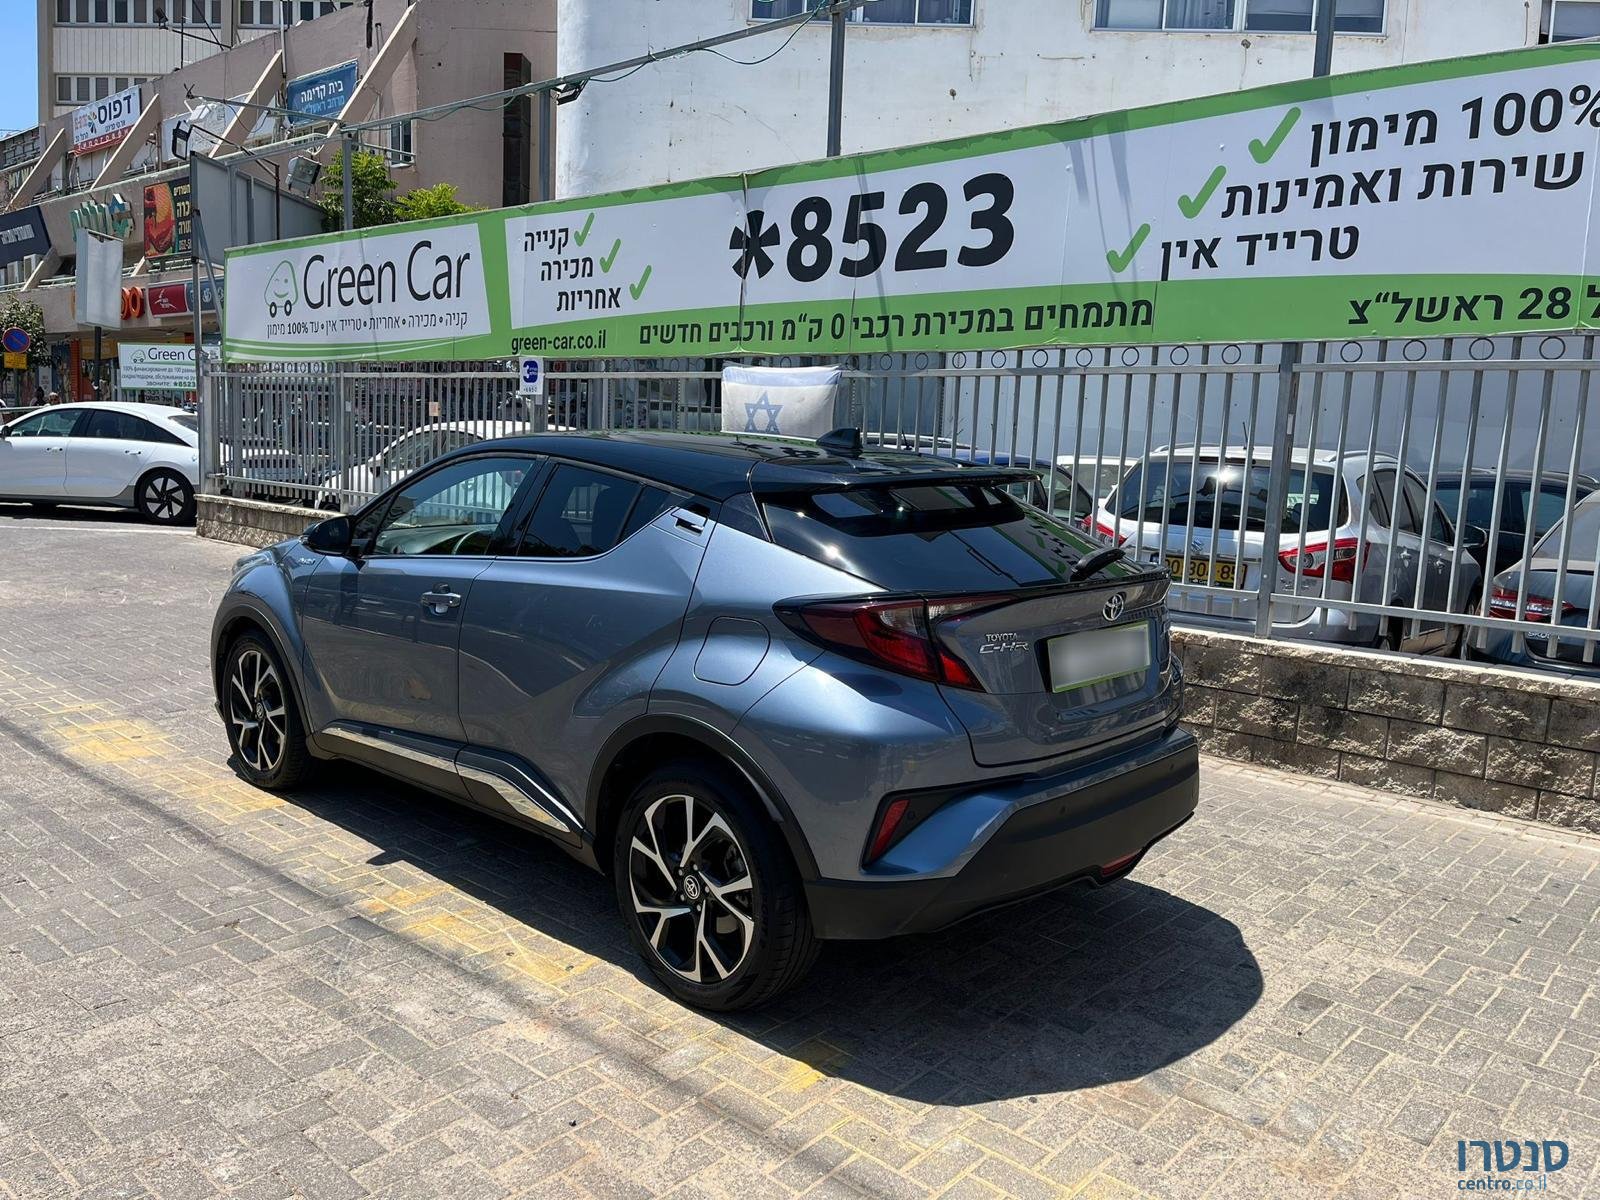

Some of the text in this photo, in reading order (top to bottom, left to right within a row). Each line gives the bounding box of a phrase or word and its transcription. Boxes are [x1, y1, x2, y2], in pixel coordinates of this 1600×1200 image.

[328, 80, 343, 95] בית
[98, 95, 131, 124] דפוס
[1310, 84, 1600, 168] 100% מימון
[1221, 151, 1584, 218] שירות ואמינות
[524, 227, 569, 255] קנייה
[1160, 225, 1360, 282] טרייד אין
[303, 240, 471, 309] Green Car
[541, 256, 593, 281] מכירה
[556, 287, 621, 312] אחריות
[1517, 286, 1572, 320] 28
[267, 312, 467, 339] קניה מכירה אחריות טרייד אין עד 100% מימון
[831, 312, 845, 340] 0
[853, 314, 904, 339] רכבי
[912, 307, 1014, 337] במכירת
[1024, 299, 1152, 331] מתמחים
[511, 329, 607, 355] green-car.co.il
[640, 323, 702, 344] חדשים
[709, 320, 774, 342] ורכבים
[148, 347, 185, 361] Green
[979, 641, 1029, 654] C-HR
[985, 632, 1017, 642] TOYOTA
